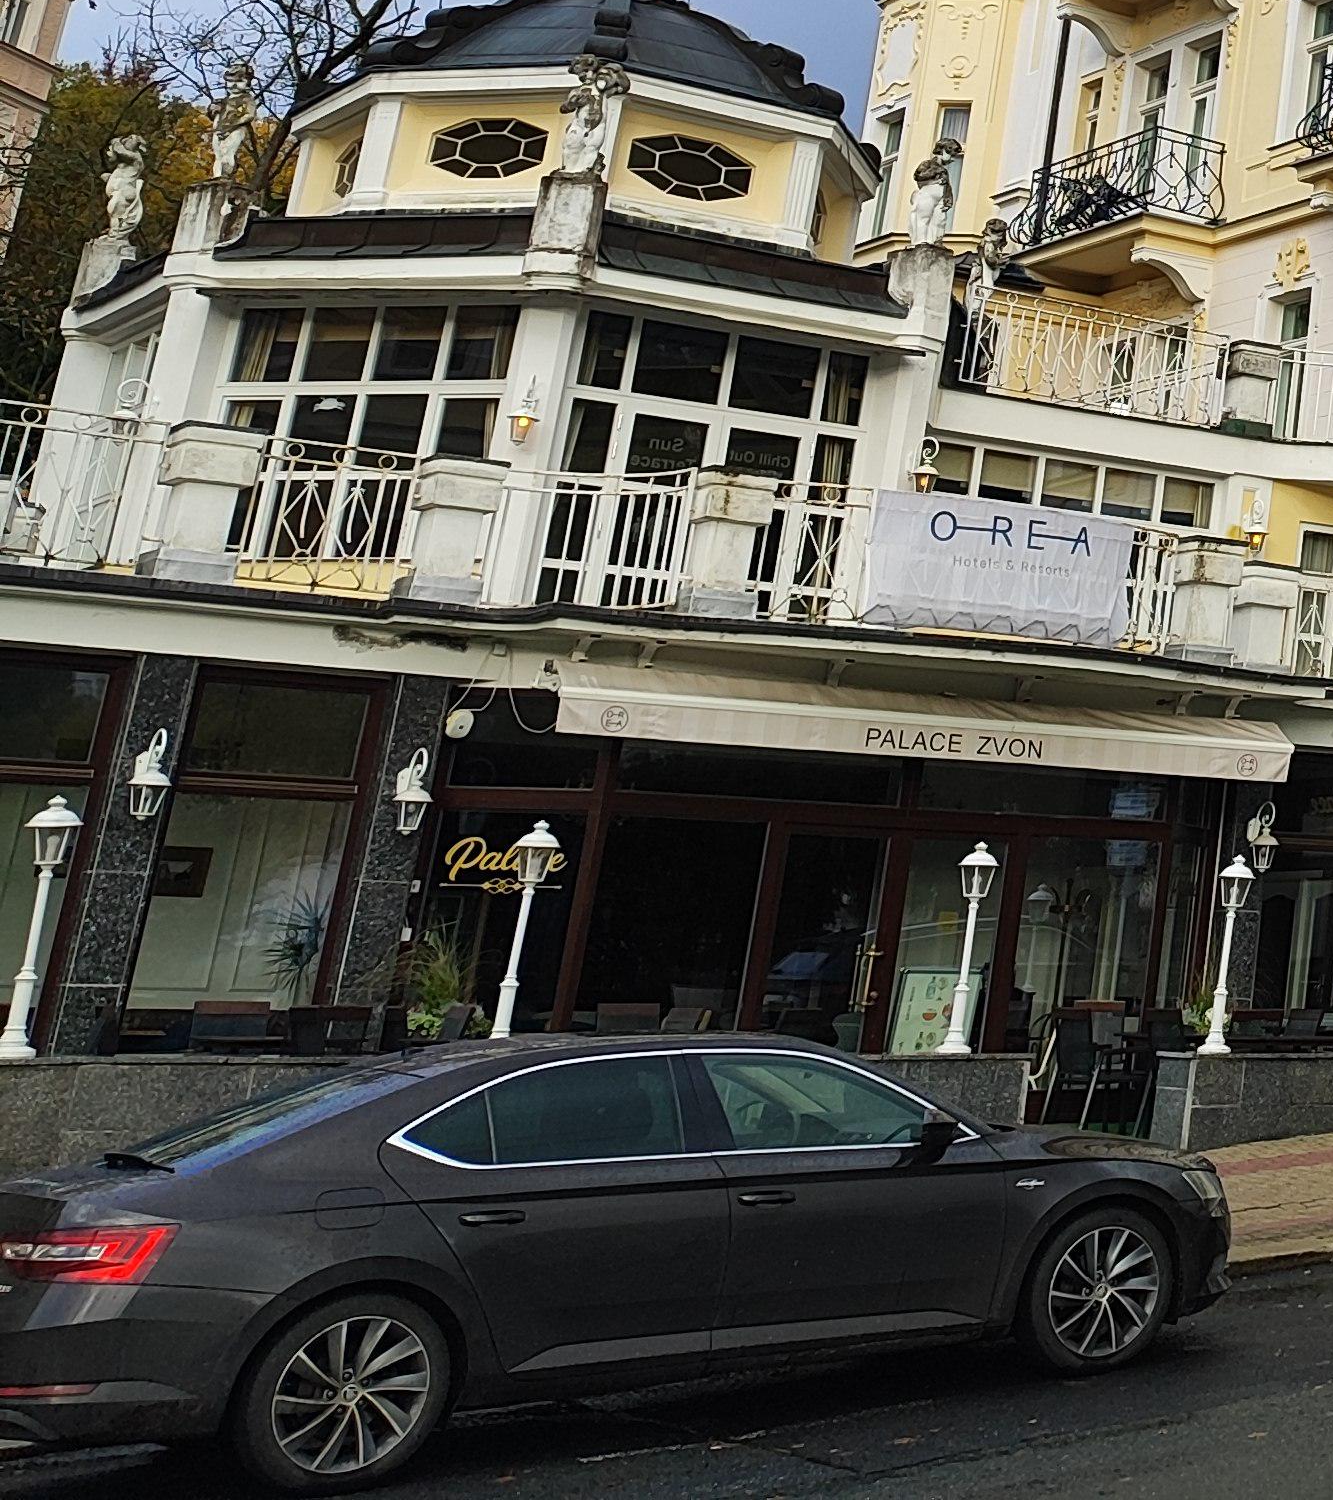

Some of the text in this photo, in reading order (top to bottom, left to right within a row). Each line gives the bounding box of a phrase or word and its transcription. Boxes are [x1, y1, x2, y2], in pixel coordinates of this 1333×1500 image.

[953, 555, 1070, 577] Hotels & Resorts
[865, 728, 1043, 759] PALACE ZVON
[445, 836, 568, 881] Pale
